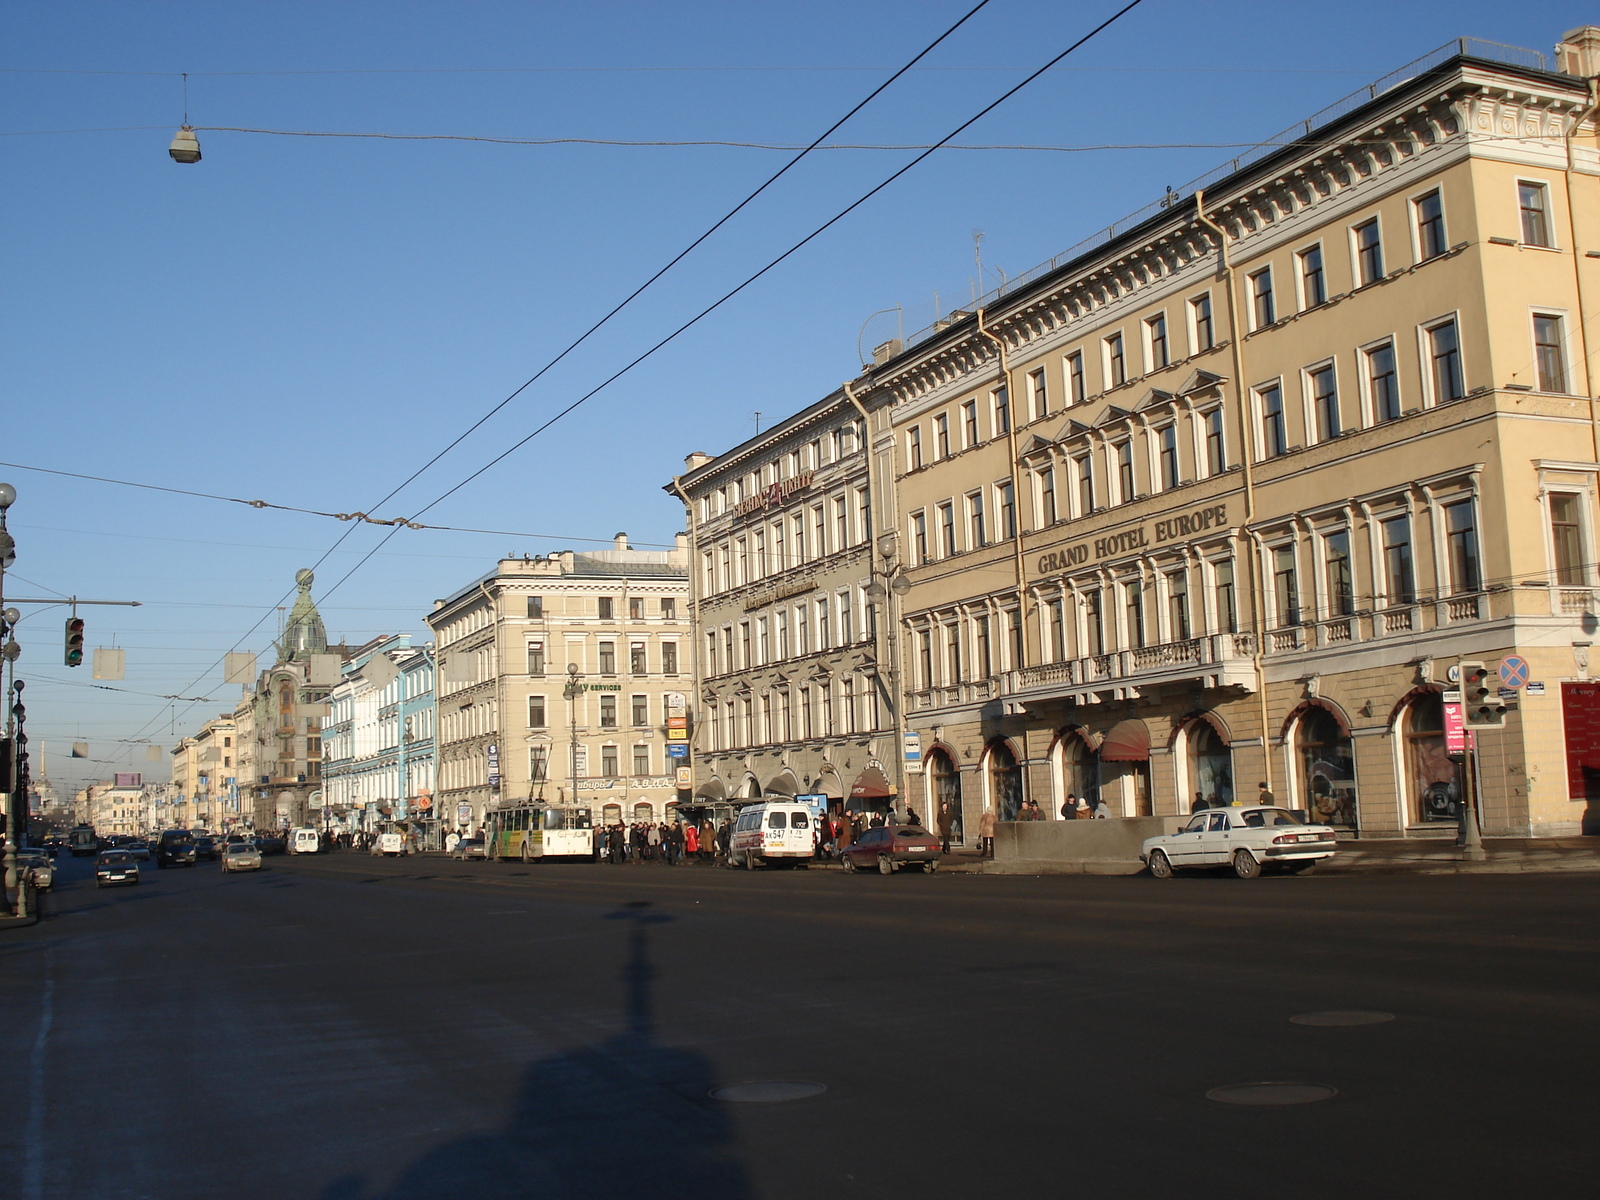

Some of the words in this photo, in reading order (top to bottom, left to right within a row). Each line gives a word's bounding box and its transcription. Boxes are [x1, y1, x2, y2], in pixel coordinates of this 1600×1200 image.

[1038, 544, 1089, 574] GRAND
[1094, 527, 1149, 559] HOTEL
[1154, 504, 1228, 543] EUROPE
[631, 779, 676, 789] АВИА
